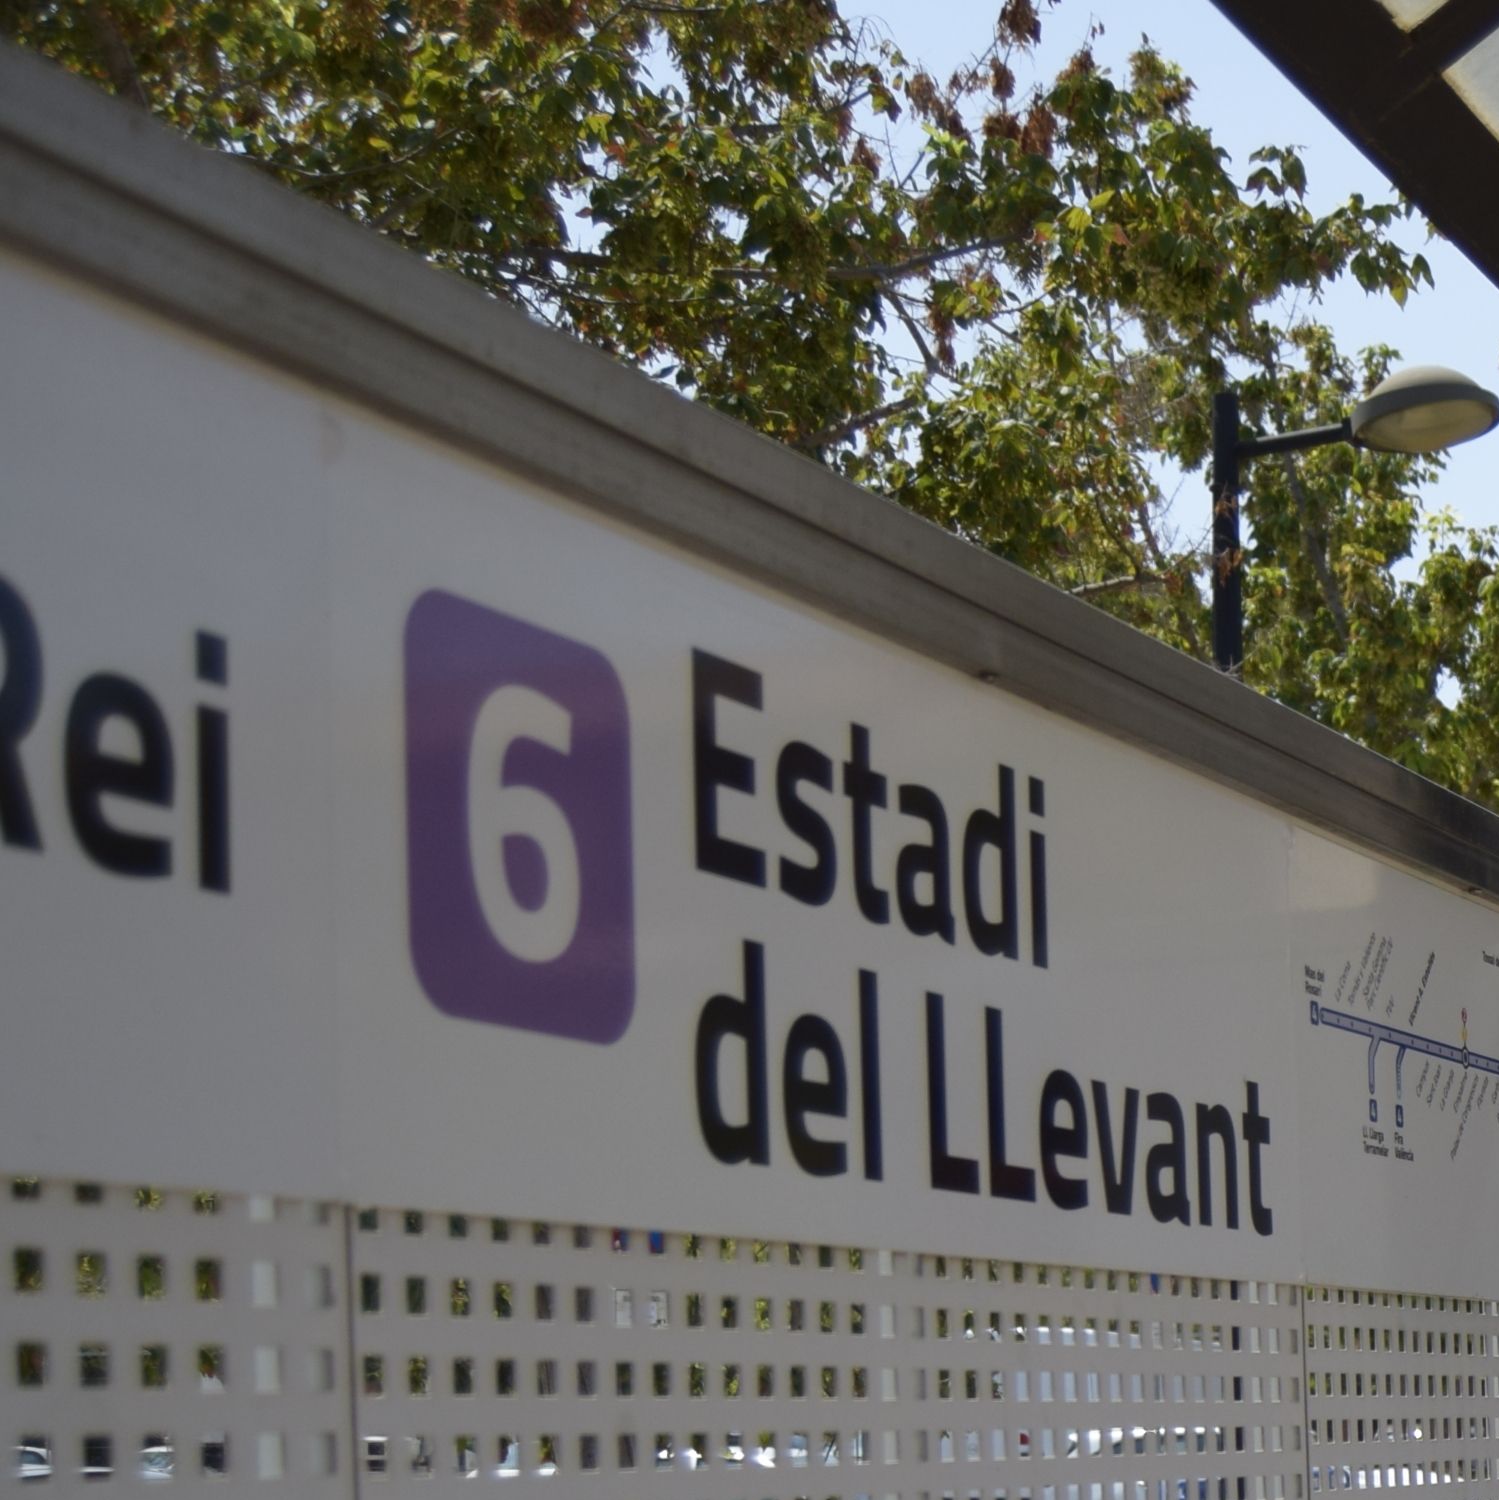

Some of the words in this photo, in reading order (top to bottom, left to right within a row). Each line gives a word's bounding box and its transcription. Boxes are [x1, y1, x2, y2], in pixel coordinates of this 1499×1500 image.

[467, 684, 582, 964] 6
[692, 647, 1049, 969] Estadi
[696, 938, 883, 1182] del
[925, 990, 1274, 1237] LLevant
